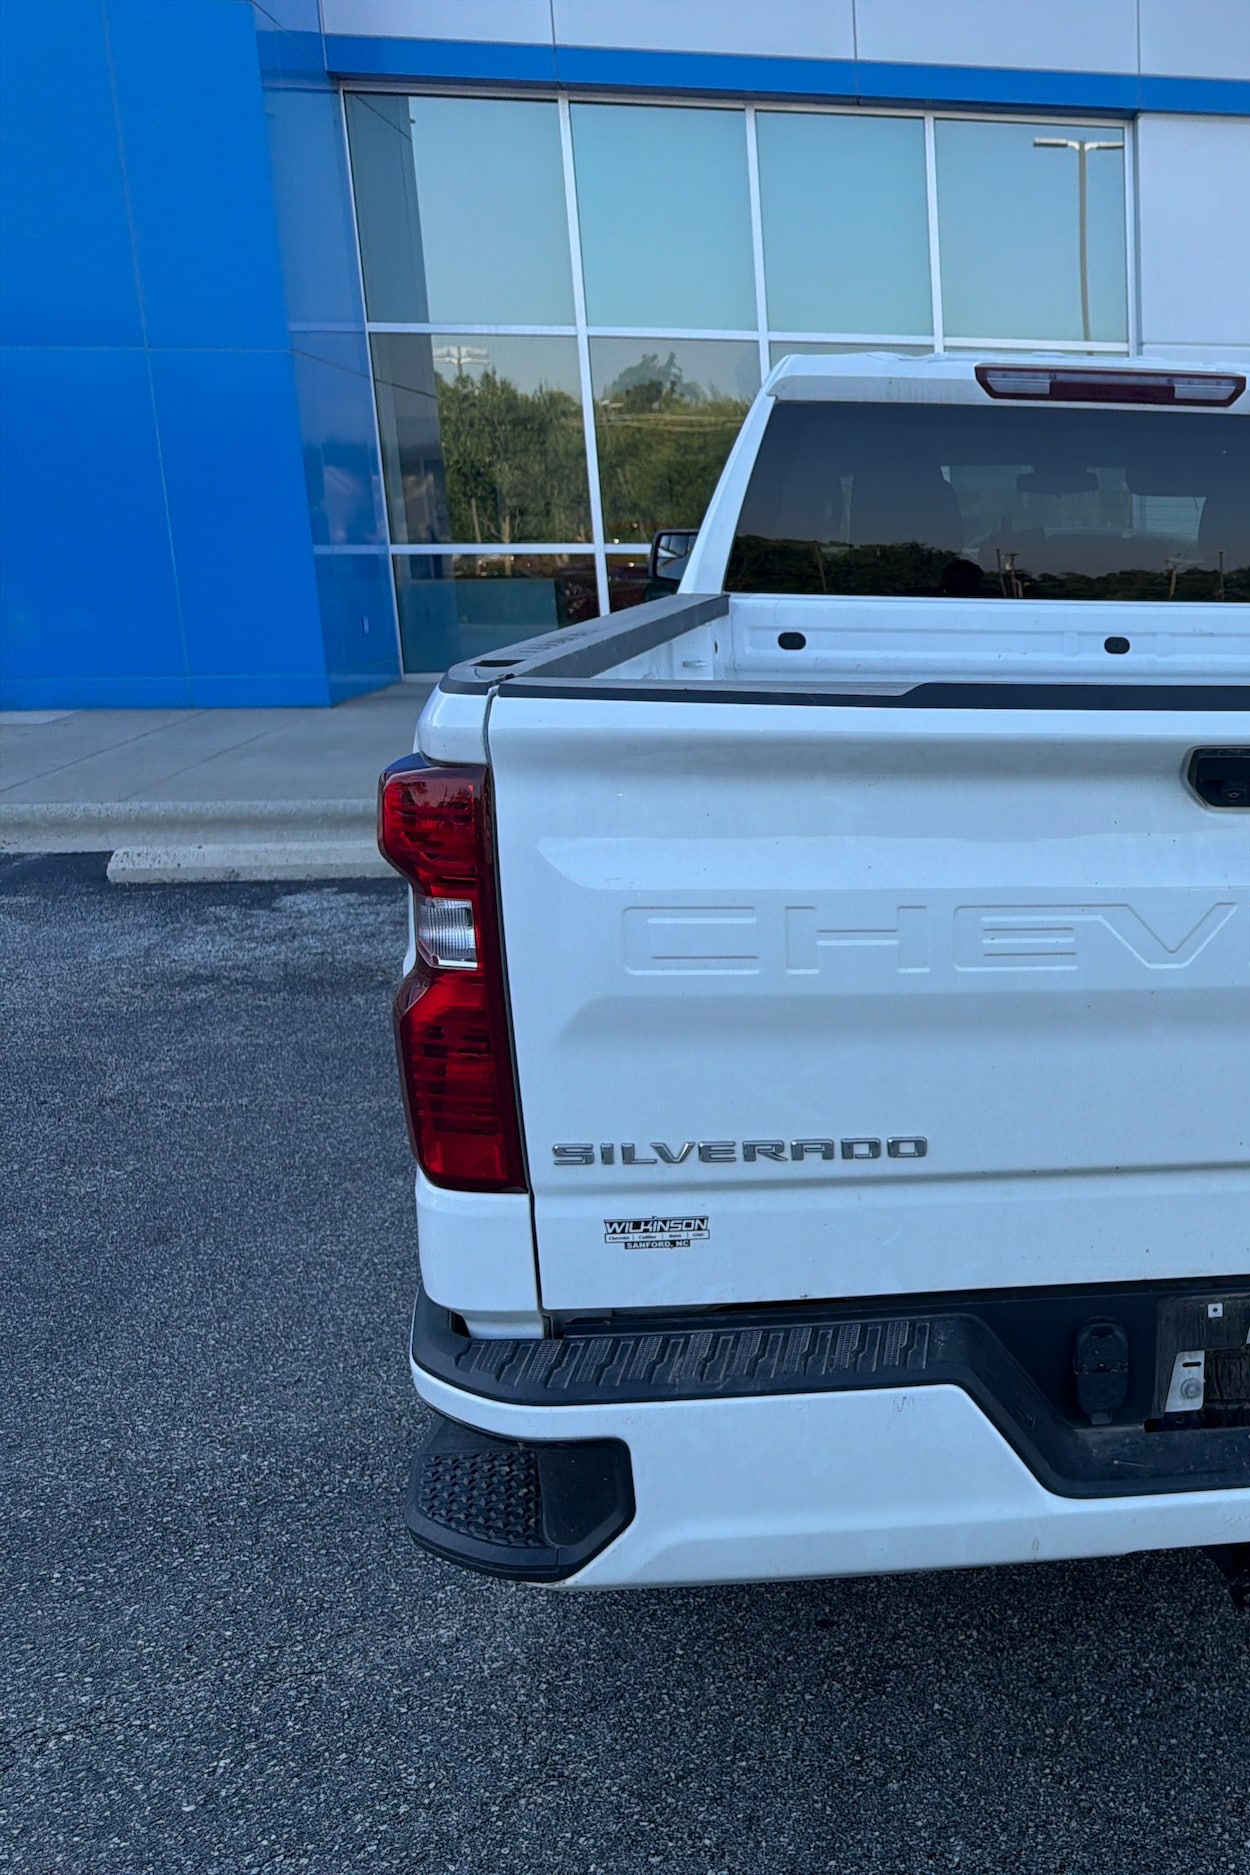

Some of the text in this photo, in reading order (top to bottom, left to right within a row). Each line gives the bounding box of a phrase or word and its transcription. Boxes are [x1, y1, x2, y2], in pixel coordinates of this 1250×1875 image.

[552, 1136, 928, 1166] SILVERADO
[605, 1219, 708, 1233] WILKINSON
[626, 1241, 674, 1249] SANFORD,
